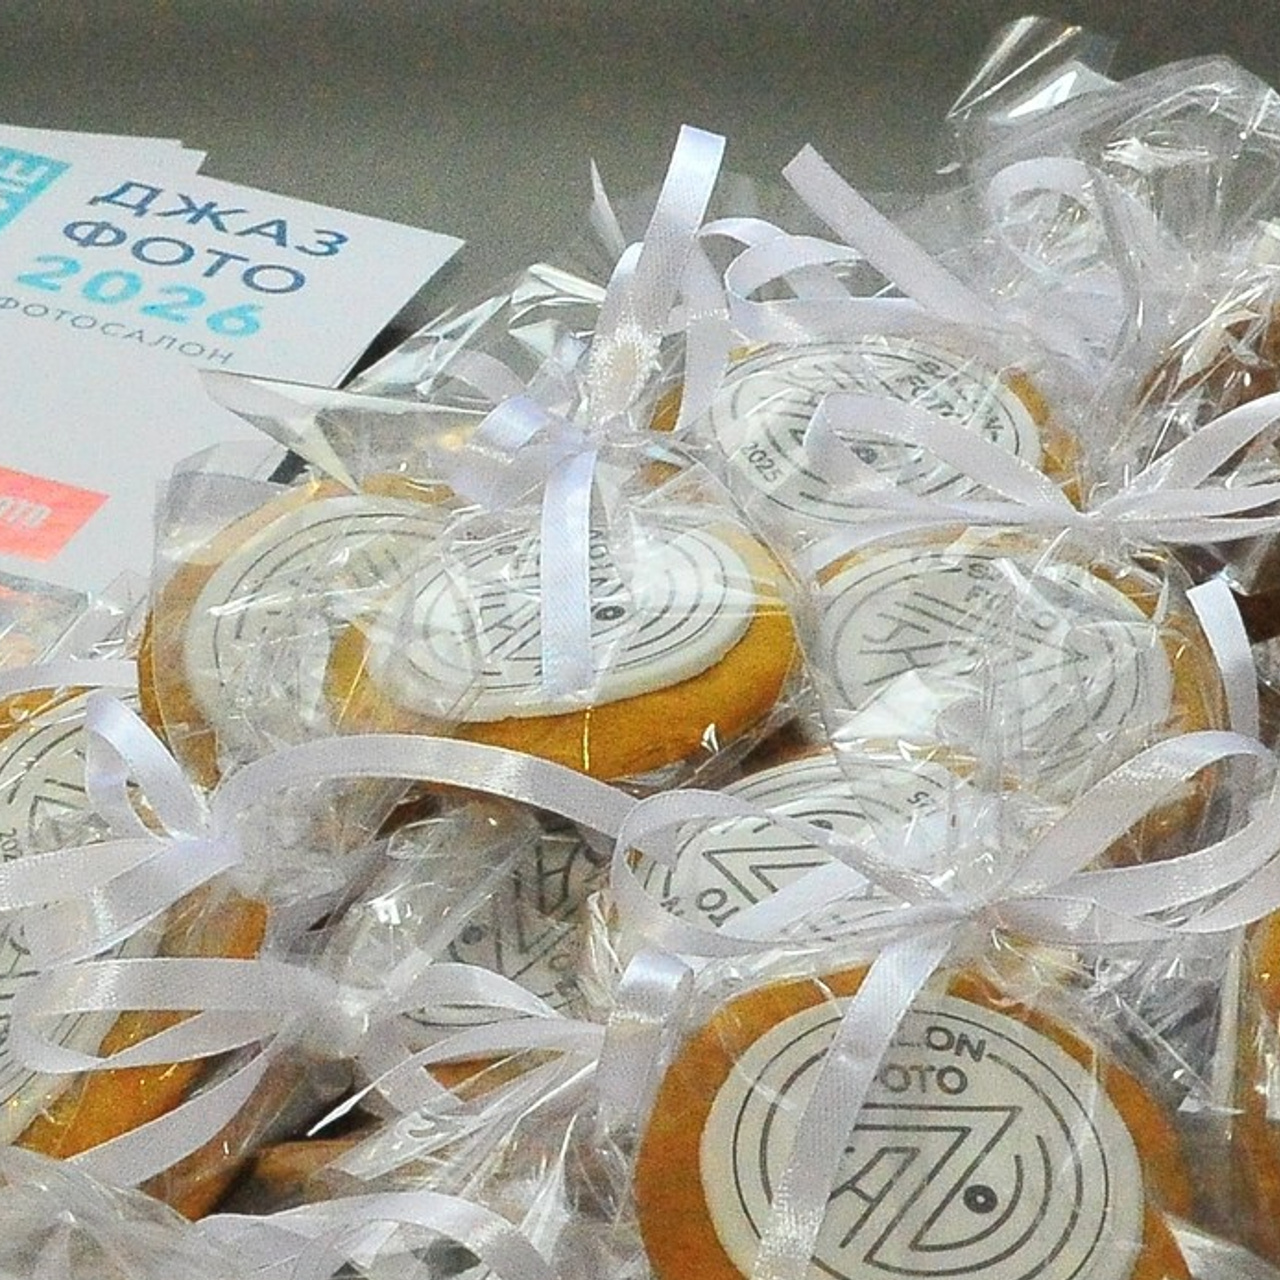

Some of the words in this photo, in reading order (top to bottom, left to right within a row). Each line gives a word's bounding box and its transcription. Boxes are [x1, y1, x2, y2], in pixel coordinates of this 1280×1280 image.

[63, 218, 307, 295] ФОТО
[87, 180, 350, 257] ДЖАЗ
[16, 254, 263, 338] 2026
[875, 1063, 969, 1095] OTO
